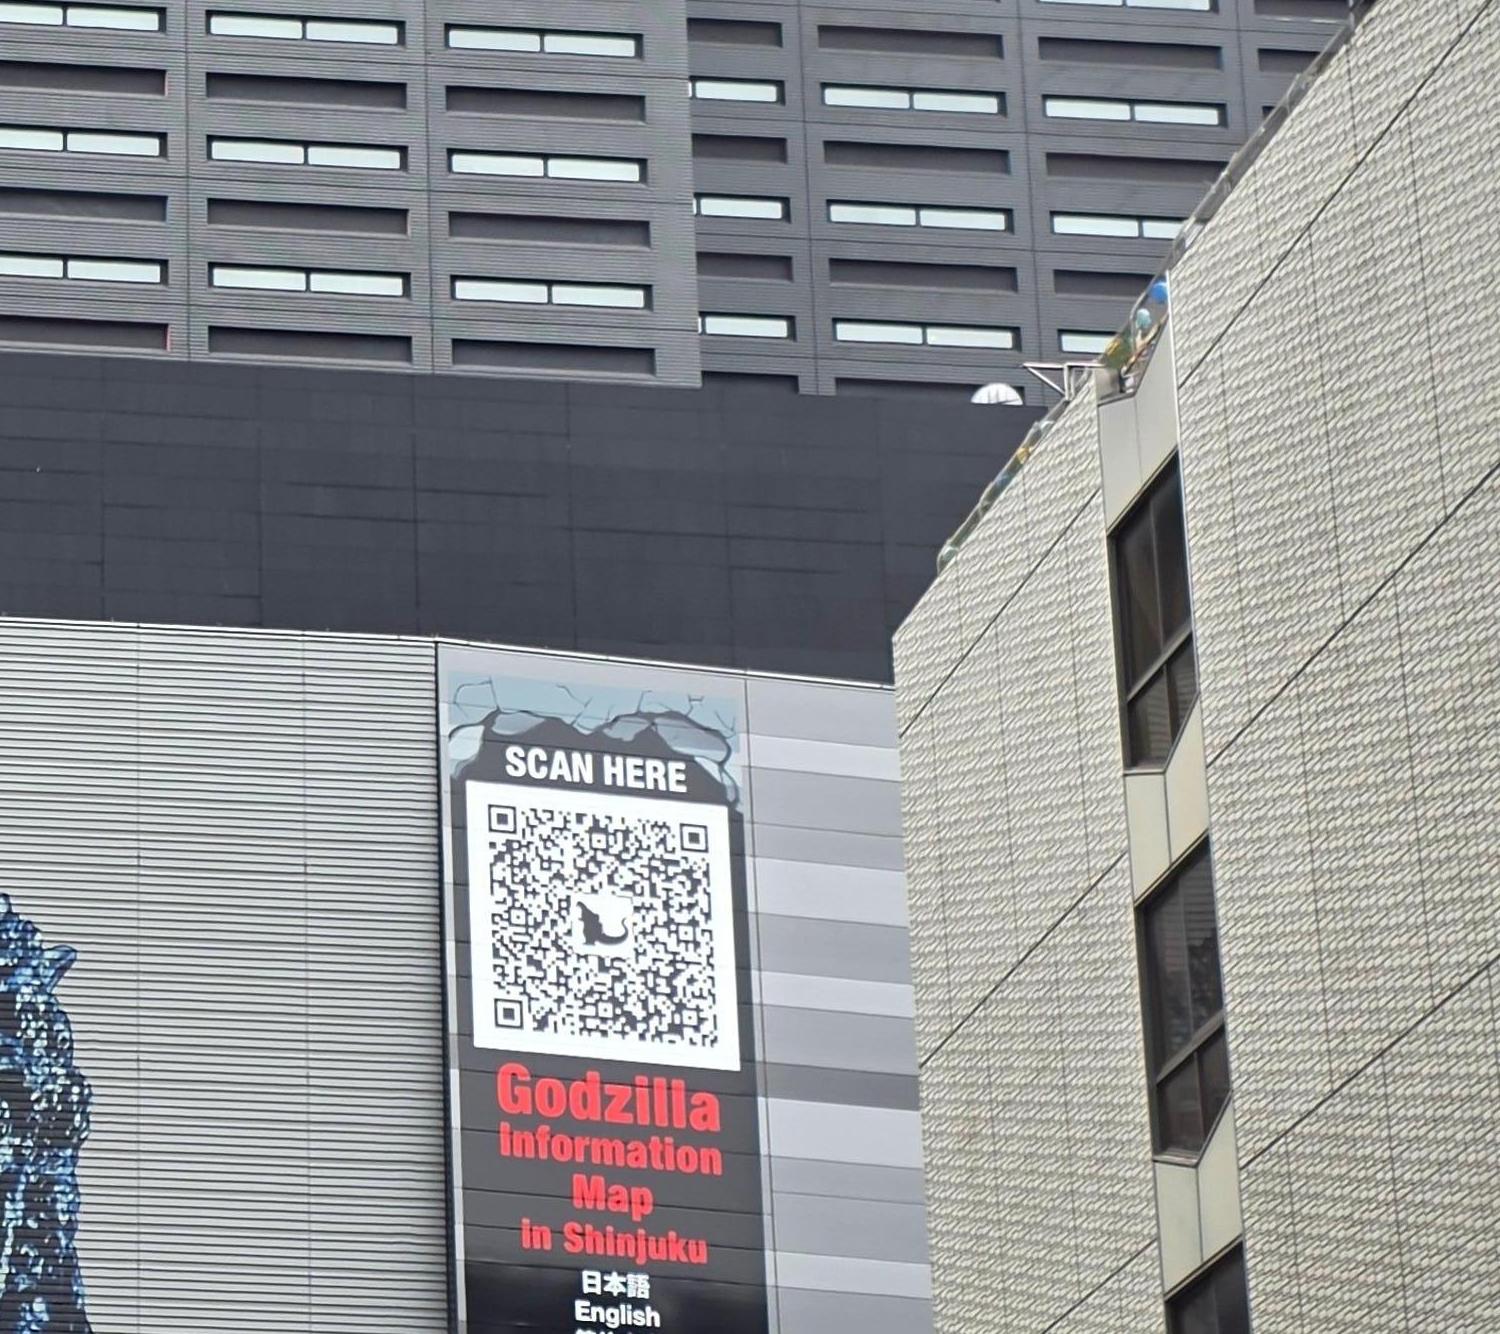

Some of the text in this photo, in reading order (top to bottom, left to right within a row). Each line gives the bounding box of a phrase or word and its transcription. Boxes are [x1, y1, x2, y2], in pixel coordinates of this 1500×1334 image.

[505, 745, 688, 794] SCAN HERE
[497, 1062, 720, 1131] Godzilla
[499, 1122, 723, 1176] Information
[572, 1173, 654, 1222] Map
[521, 1218, 708, 1265] in Shinjuku
[581, 1270, 651, 1299] 日本語
[574, 1299, 661, 1329] English
